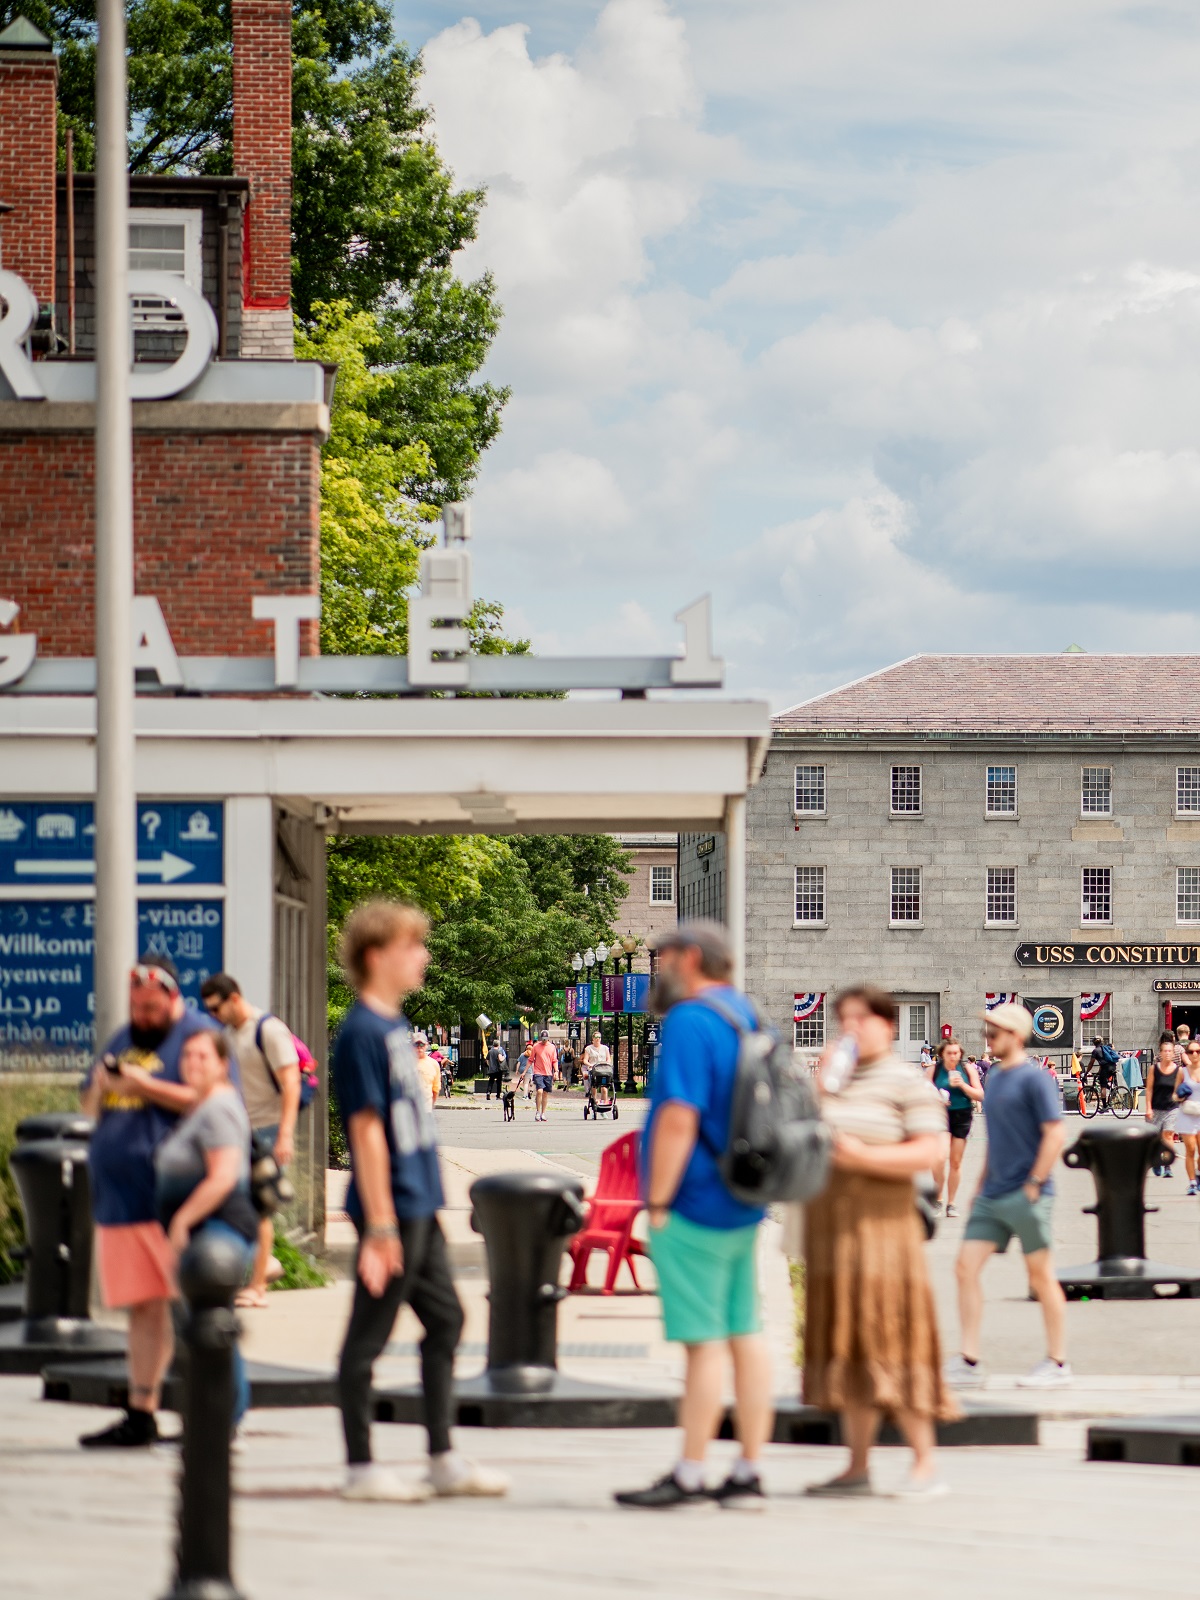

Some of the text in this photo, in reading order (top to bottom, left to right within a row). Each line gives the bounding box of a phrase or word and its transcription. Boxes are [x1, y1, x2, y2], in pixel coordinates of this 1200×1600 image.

[671, 592, 723, 688] 1
[0, 905, 77, 928] うこそ
[1035, 946, 1075, 963] USS
